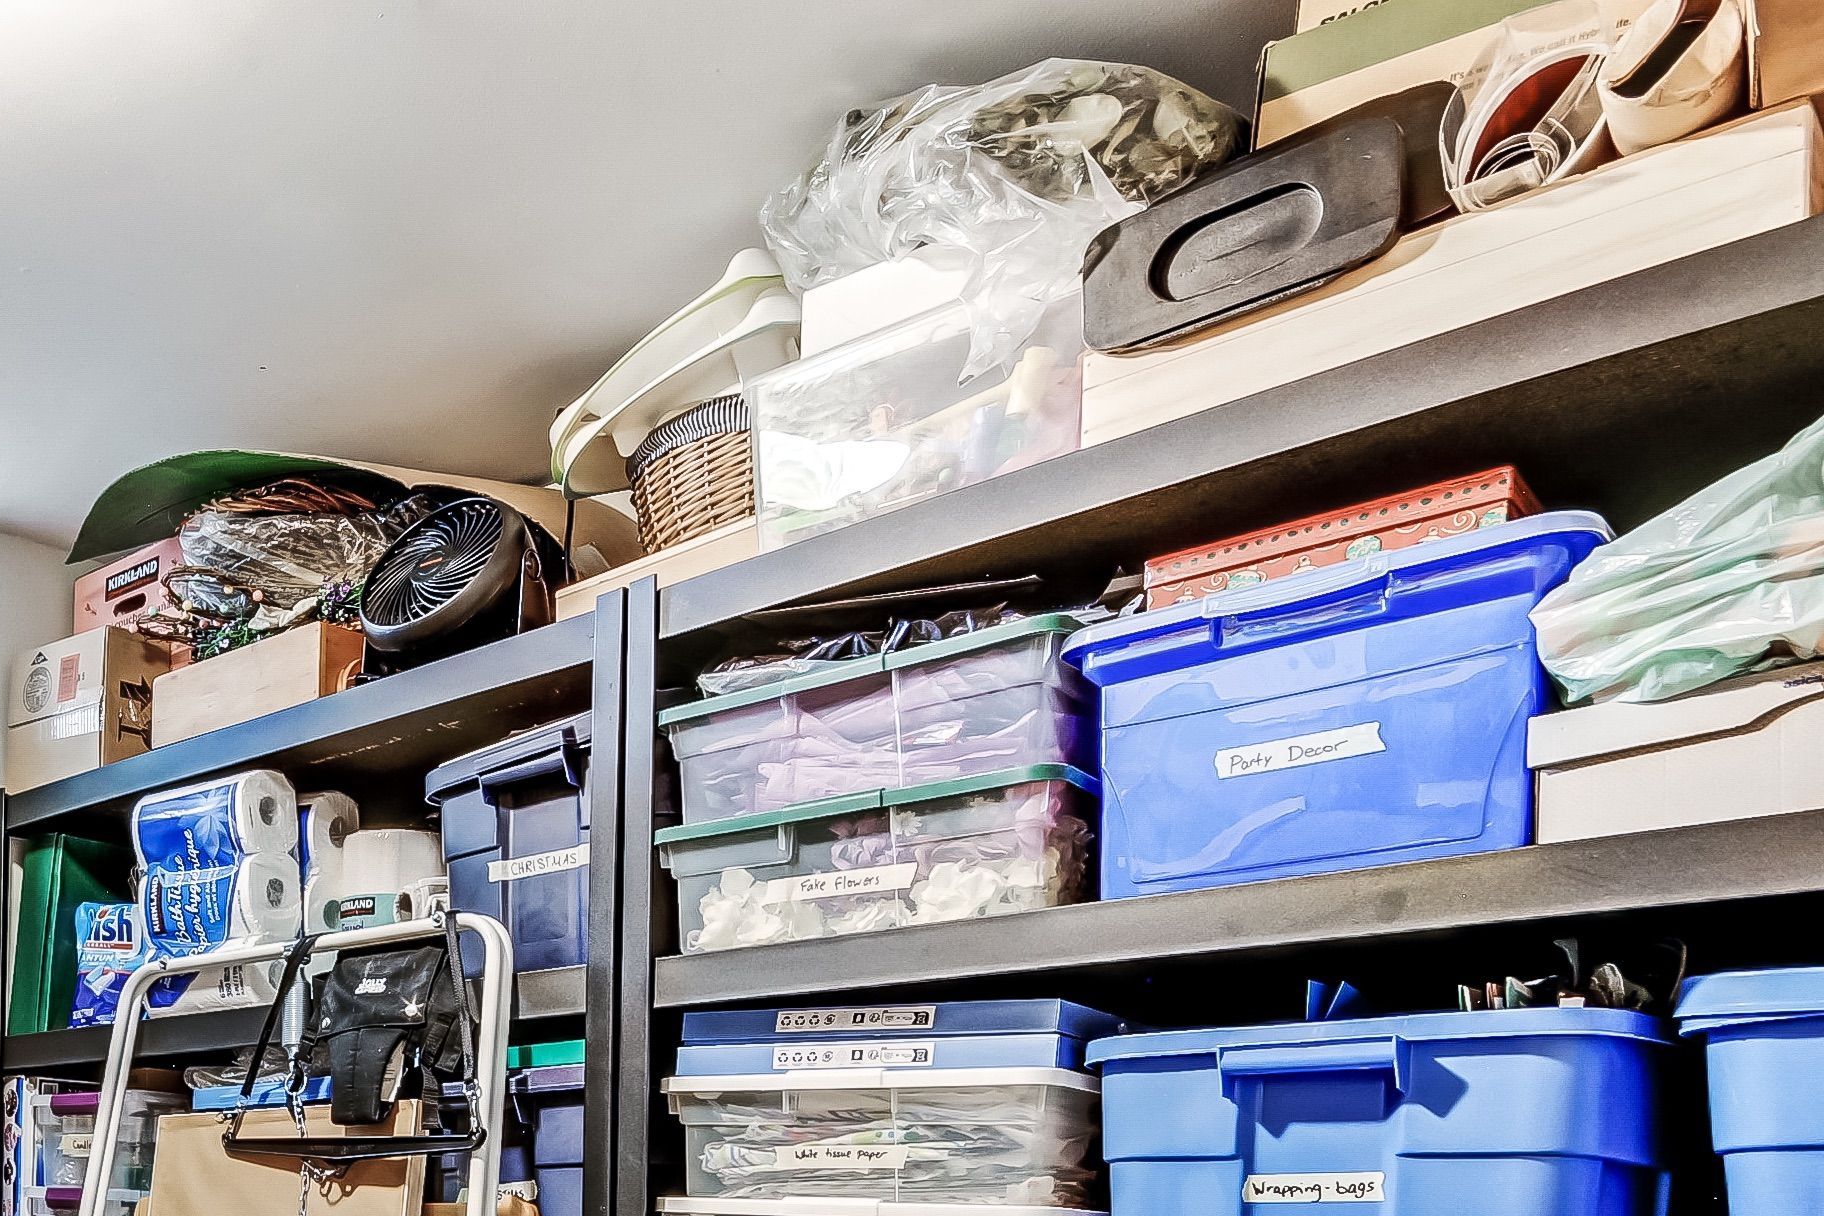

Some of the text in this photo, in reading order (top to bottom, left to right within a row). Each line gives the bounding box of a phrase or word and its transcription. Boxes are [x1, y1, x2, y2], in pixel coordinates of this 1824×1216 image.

[107, 560, 158, 592] KIRKLAND
[1230, 739, 1349, 774] Party Decor
[510, 853, 577, 876] CHRISTMAS
[800, 875, 880, 892] Fake Flowers
[150, 876, 161, 933] KIRKLAND
[168, 903, 192, 944] Bath
[825, 1147, 852, 1158] tissue
[857, 1150, 888, 1161] paper
[1252, 1181, 1322, 1203] Wrapping
[1335, 1181, 1375, 1199] bags
